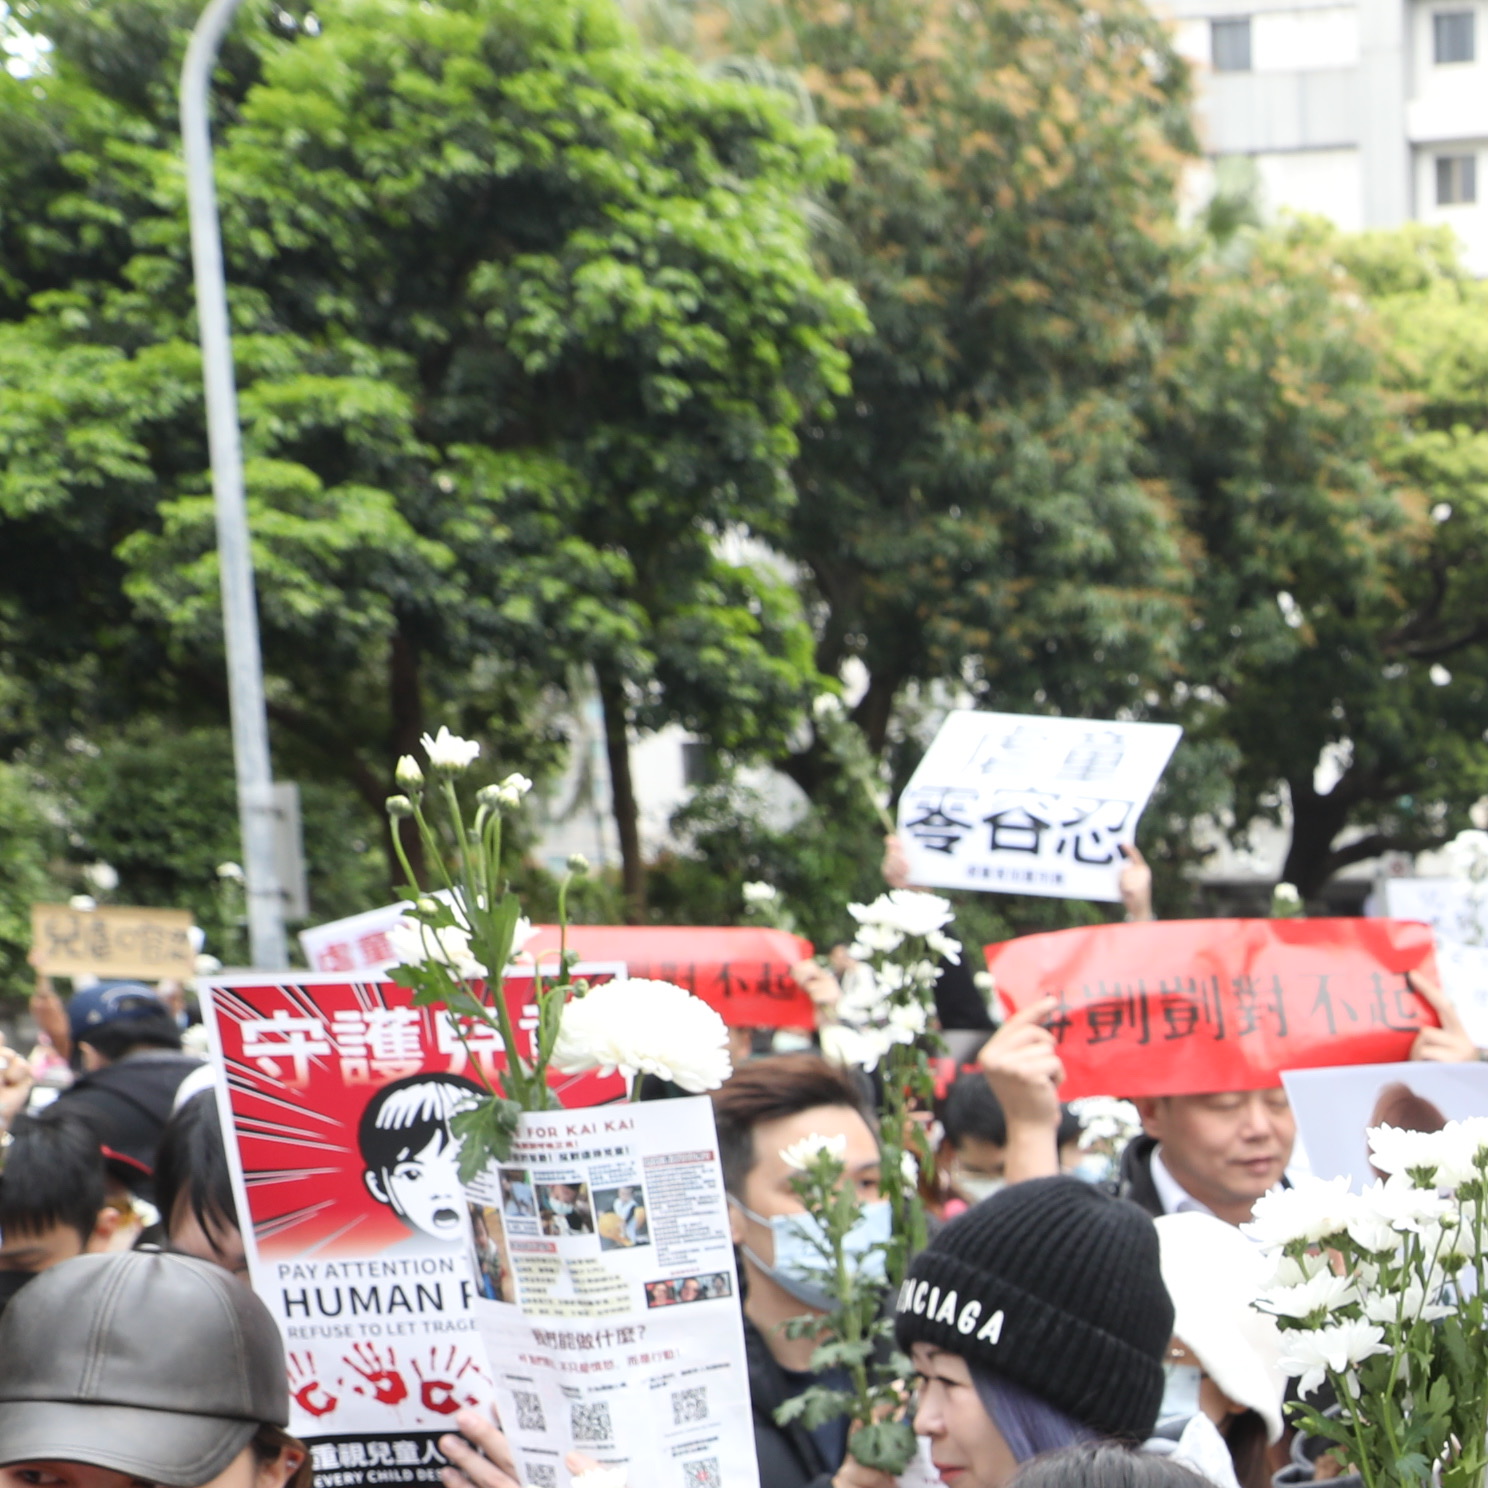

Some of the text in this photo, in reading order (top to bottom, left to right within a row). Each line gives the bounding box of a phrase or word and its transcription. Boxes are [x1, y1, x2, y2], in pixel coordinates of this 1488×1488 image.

[905, 785, 1135, 865] 零容忍
[240, 1006, 542, 1092] 守護兒
[566, 1122, 597, 1137] KAI
[604, 1118, 635, 1132] KAI
[277, 1257, 455, 1282] PAY ATTENTION
[281, 1281, 445, 1319] HUMAN
[358, 1322, 382, 1338] TO
[386, 1321, 417, 1338] LET
[366, 1467, 415, 1486] CHILD
